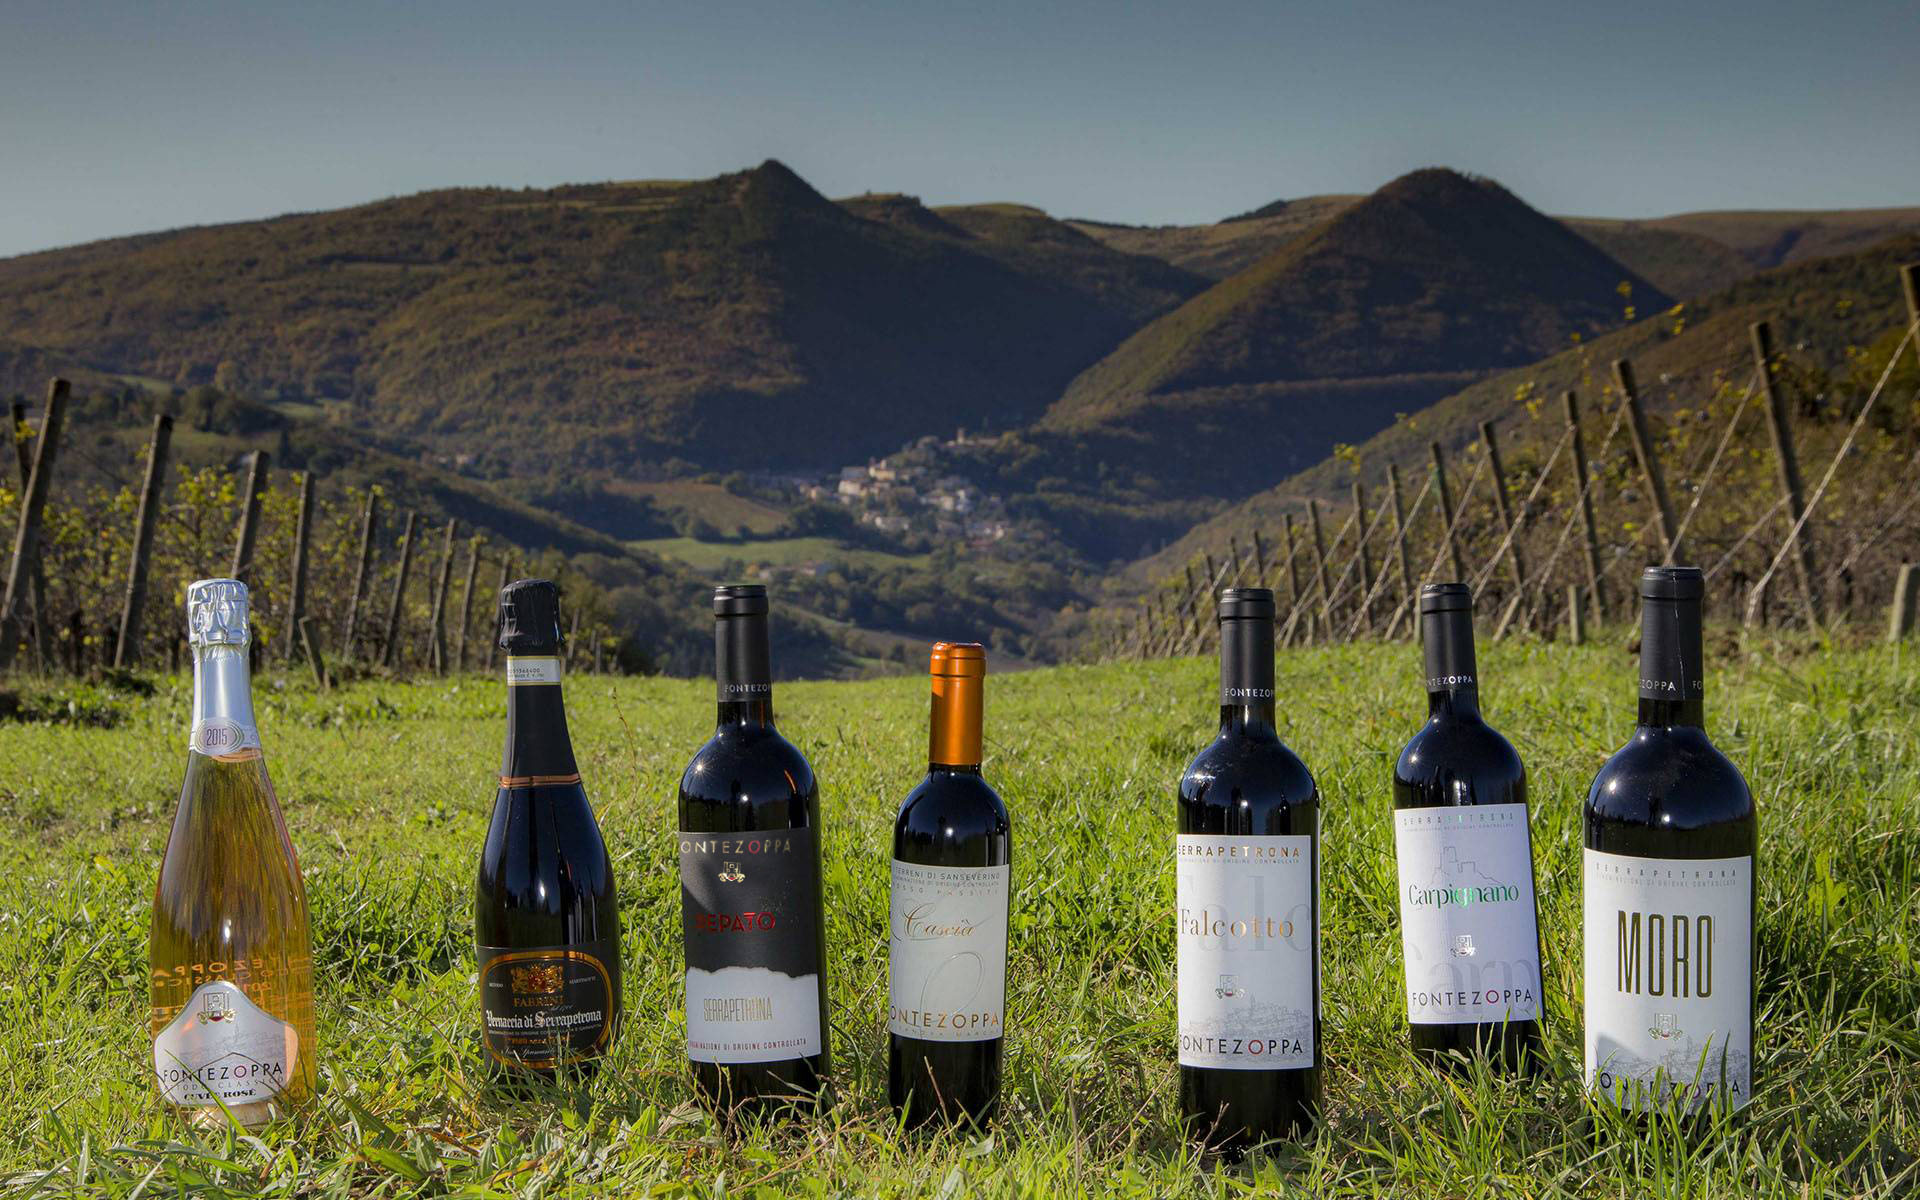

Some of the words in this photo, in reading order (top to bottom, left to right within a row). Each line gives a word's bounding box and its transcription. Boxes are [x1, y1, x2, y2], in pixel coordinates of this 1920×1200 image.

[206, 728, 228, 746] 2015
[927, 871, 937, 880] DI
[940, 871, 1000, 881] SANSEVERINO
[1408, 883, 1519, 909] Carpignano
[694, 911, 777, 933] EPATO
[1181, 908, 1295, 938] Falcotto
[1617, 909, 1713, 998] MORO
[1413, 988, 1534, 1007] FONTEZOPPA
[703, 997, 773, 1022] SERRAPETRONA
[524, 1013, 534, 1029] di
[733, 1042, 761, 1051] ORIGINE
[764, 1037, 807, 1049] CONTROLLATA
